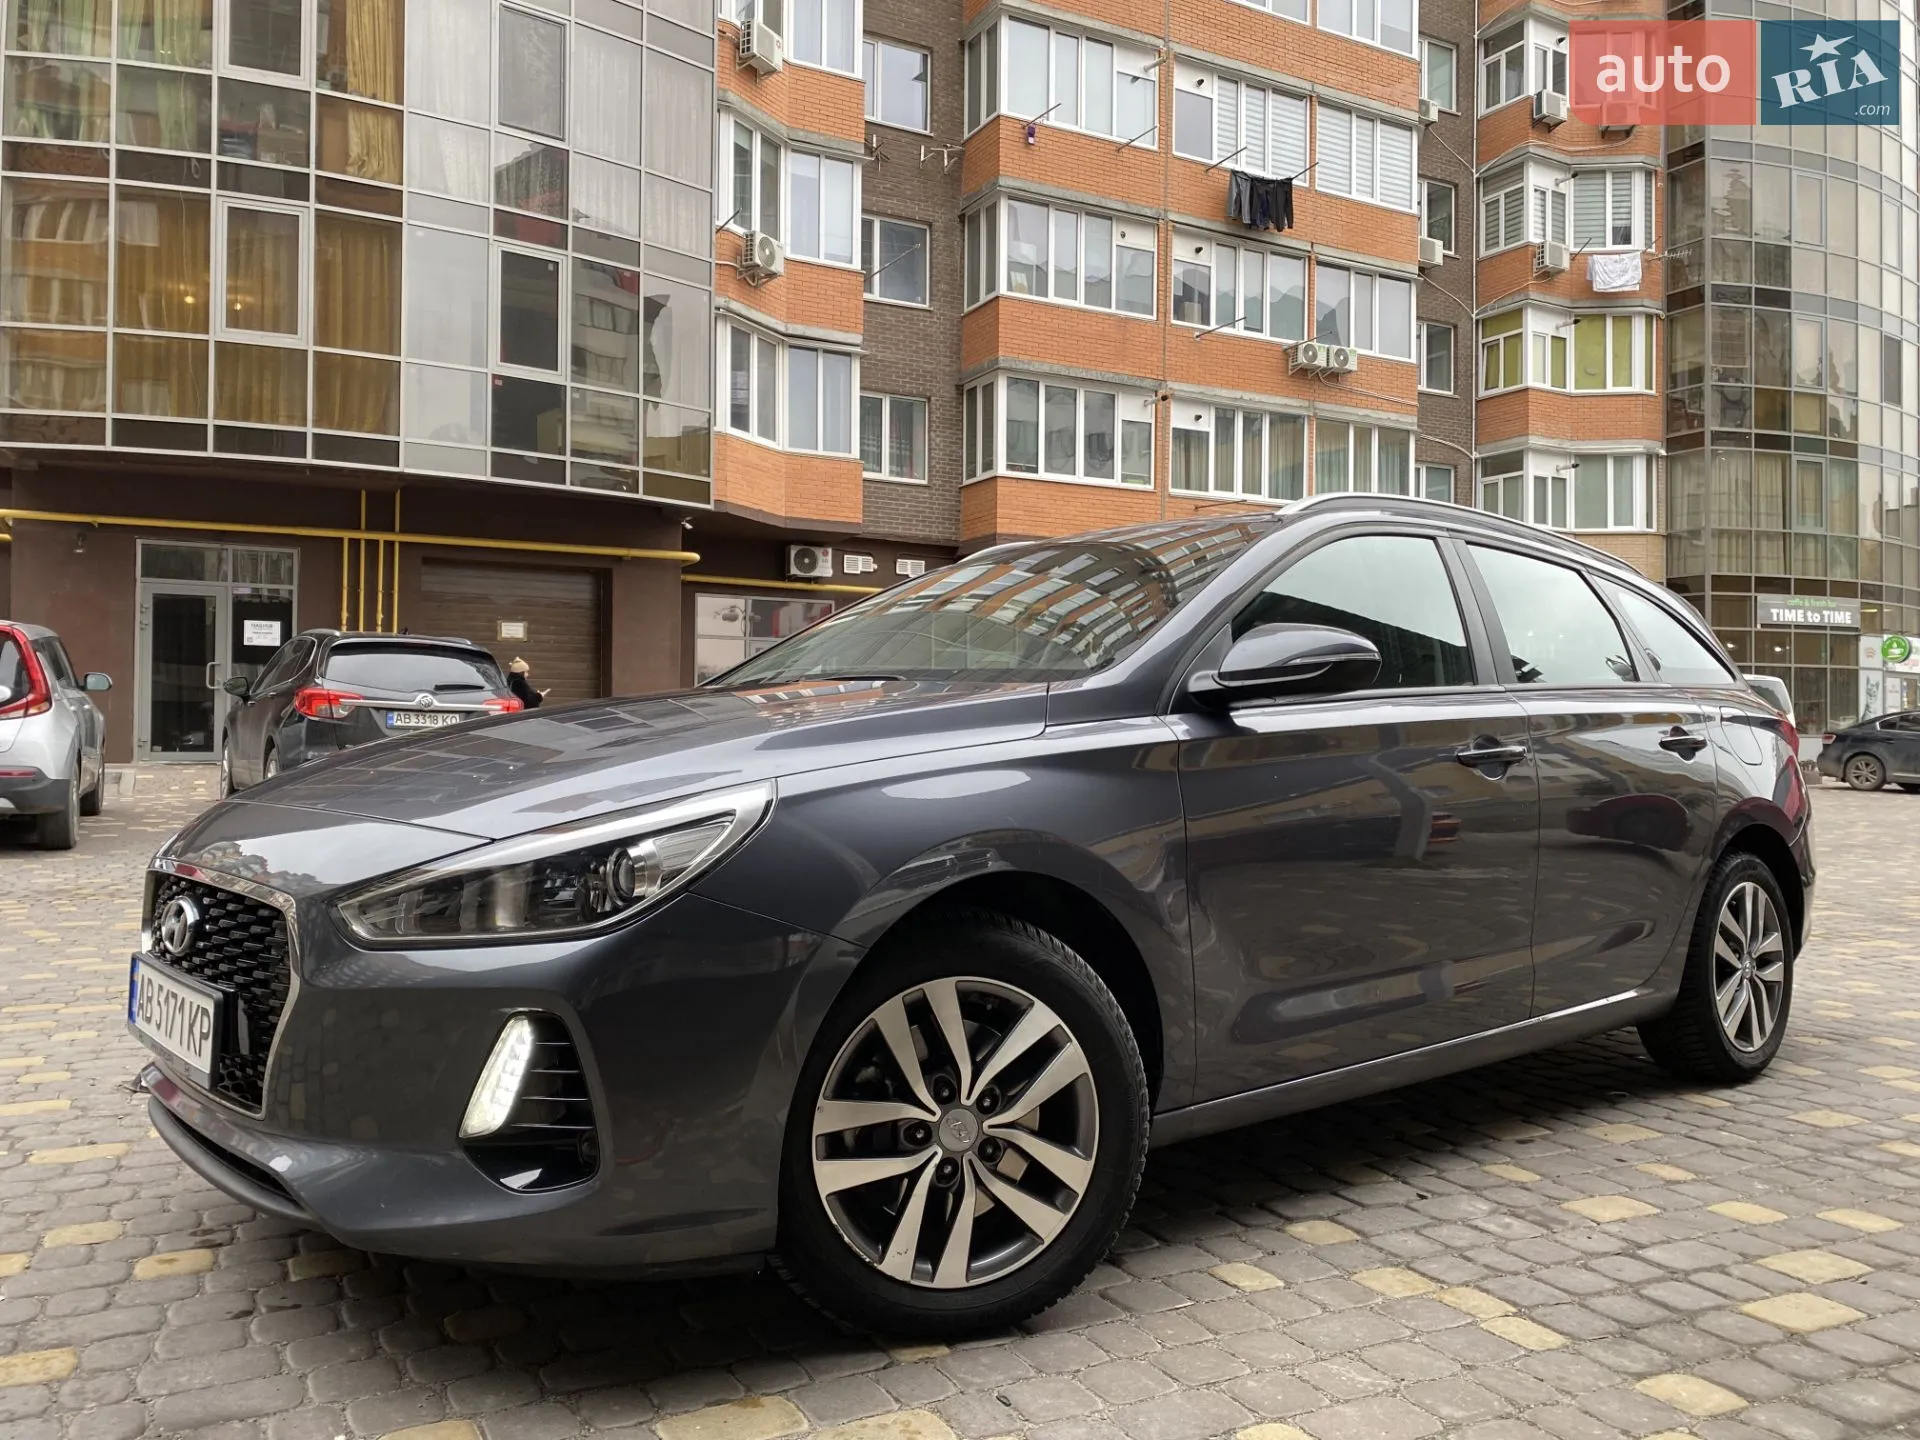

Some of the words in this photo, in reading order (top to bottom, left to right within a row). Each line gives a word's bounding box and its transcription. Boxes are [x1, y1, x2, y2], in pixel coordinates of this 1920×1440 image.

[1770, 608, 1805, 622] TIME
[1807, 610, 1821, 623] to
[1822, 610, 1852, 624] TIME
[395, 713, 411, 724] AB
[414, 713, 439, 726] 3318
[137, 973, 154, 1024] AB
[155, 983, 186, 1047] 5171
[187, 1000, 211, 1058] KP
